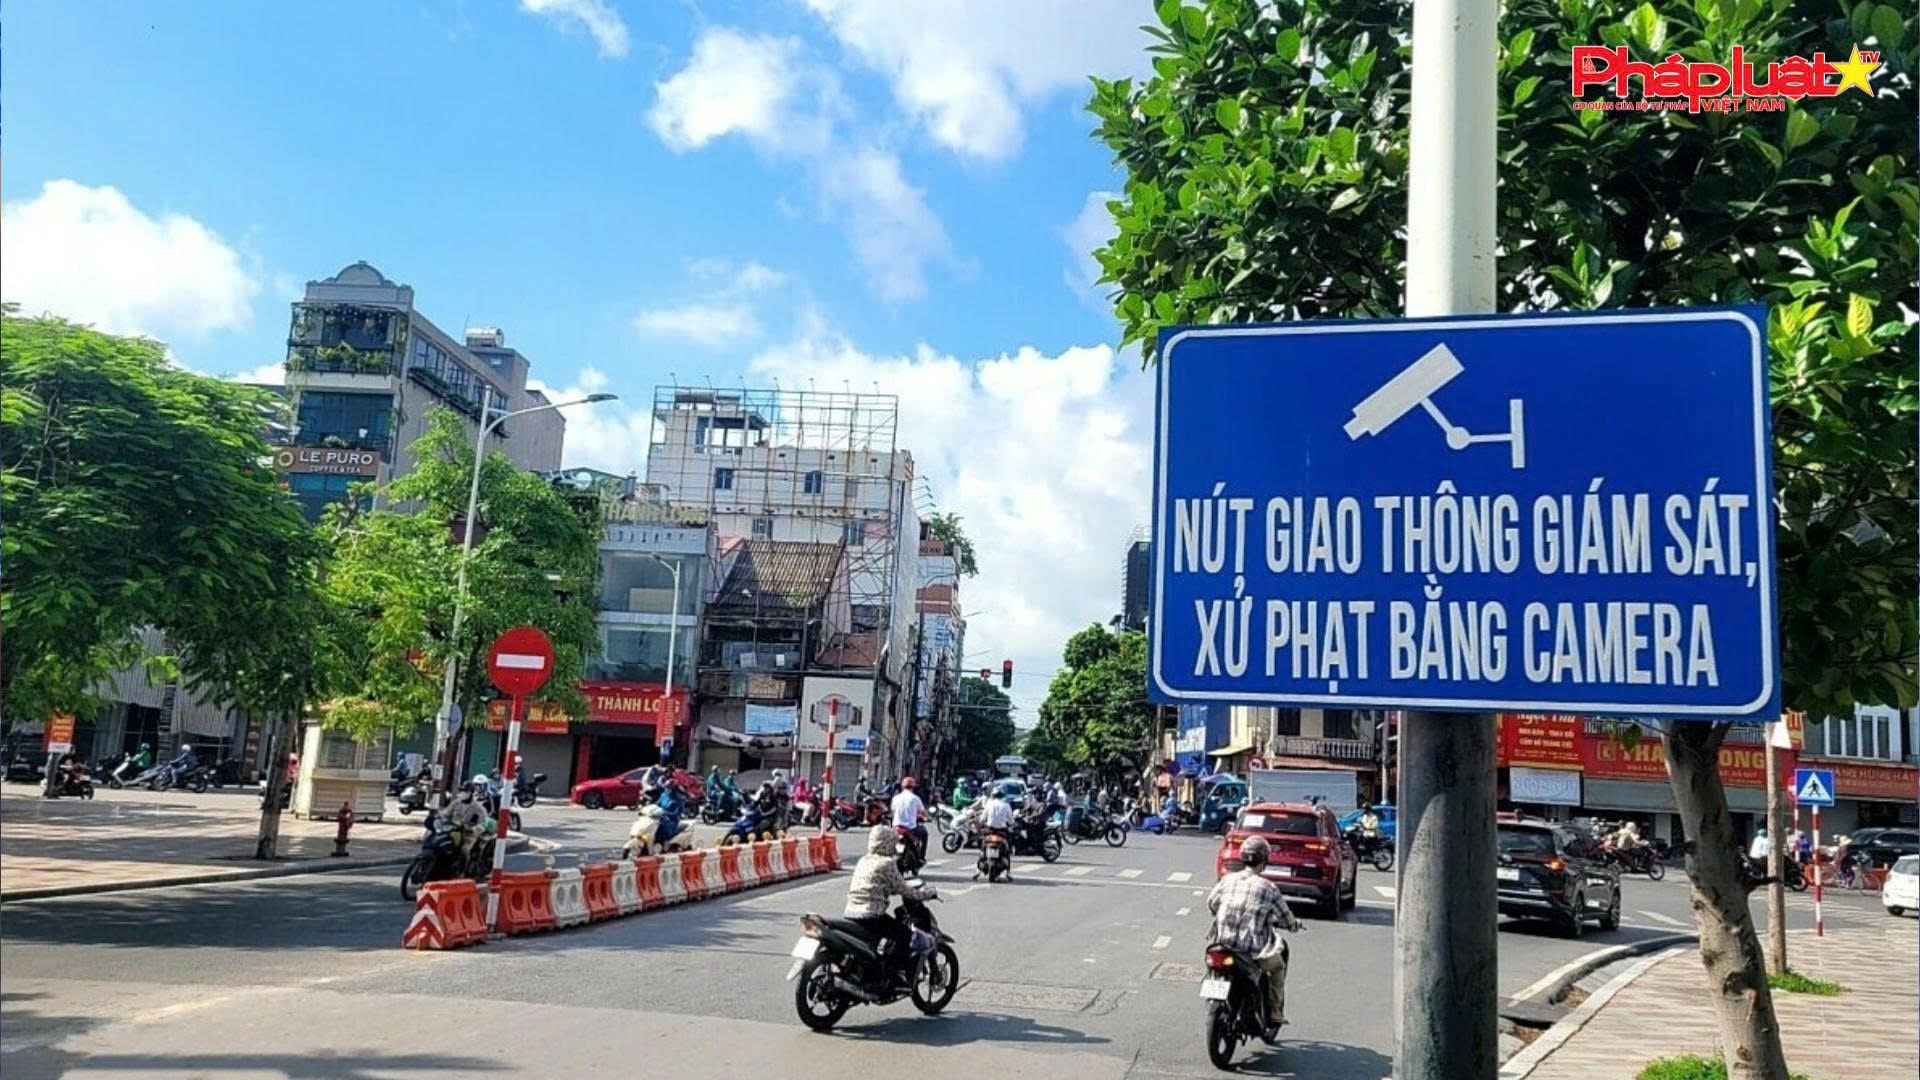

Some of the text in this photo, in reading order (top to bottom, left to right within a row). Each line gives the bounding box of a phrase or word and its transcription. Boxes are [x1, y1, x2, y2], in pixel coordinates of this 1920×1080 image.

[299, 451, 373, 465] LE PURO
[1175, 478, 1757, 588] NÚT GIAO THÔNG GIÁM SÁT,
[1195, 574, 1719, 693] XỬ PHẠT BẰNG CAMERA
[597, 693, 641, 712] THÀNH
[1718, 750, 1765, 769] ONG
